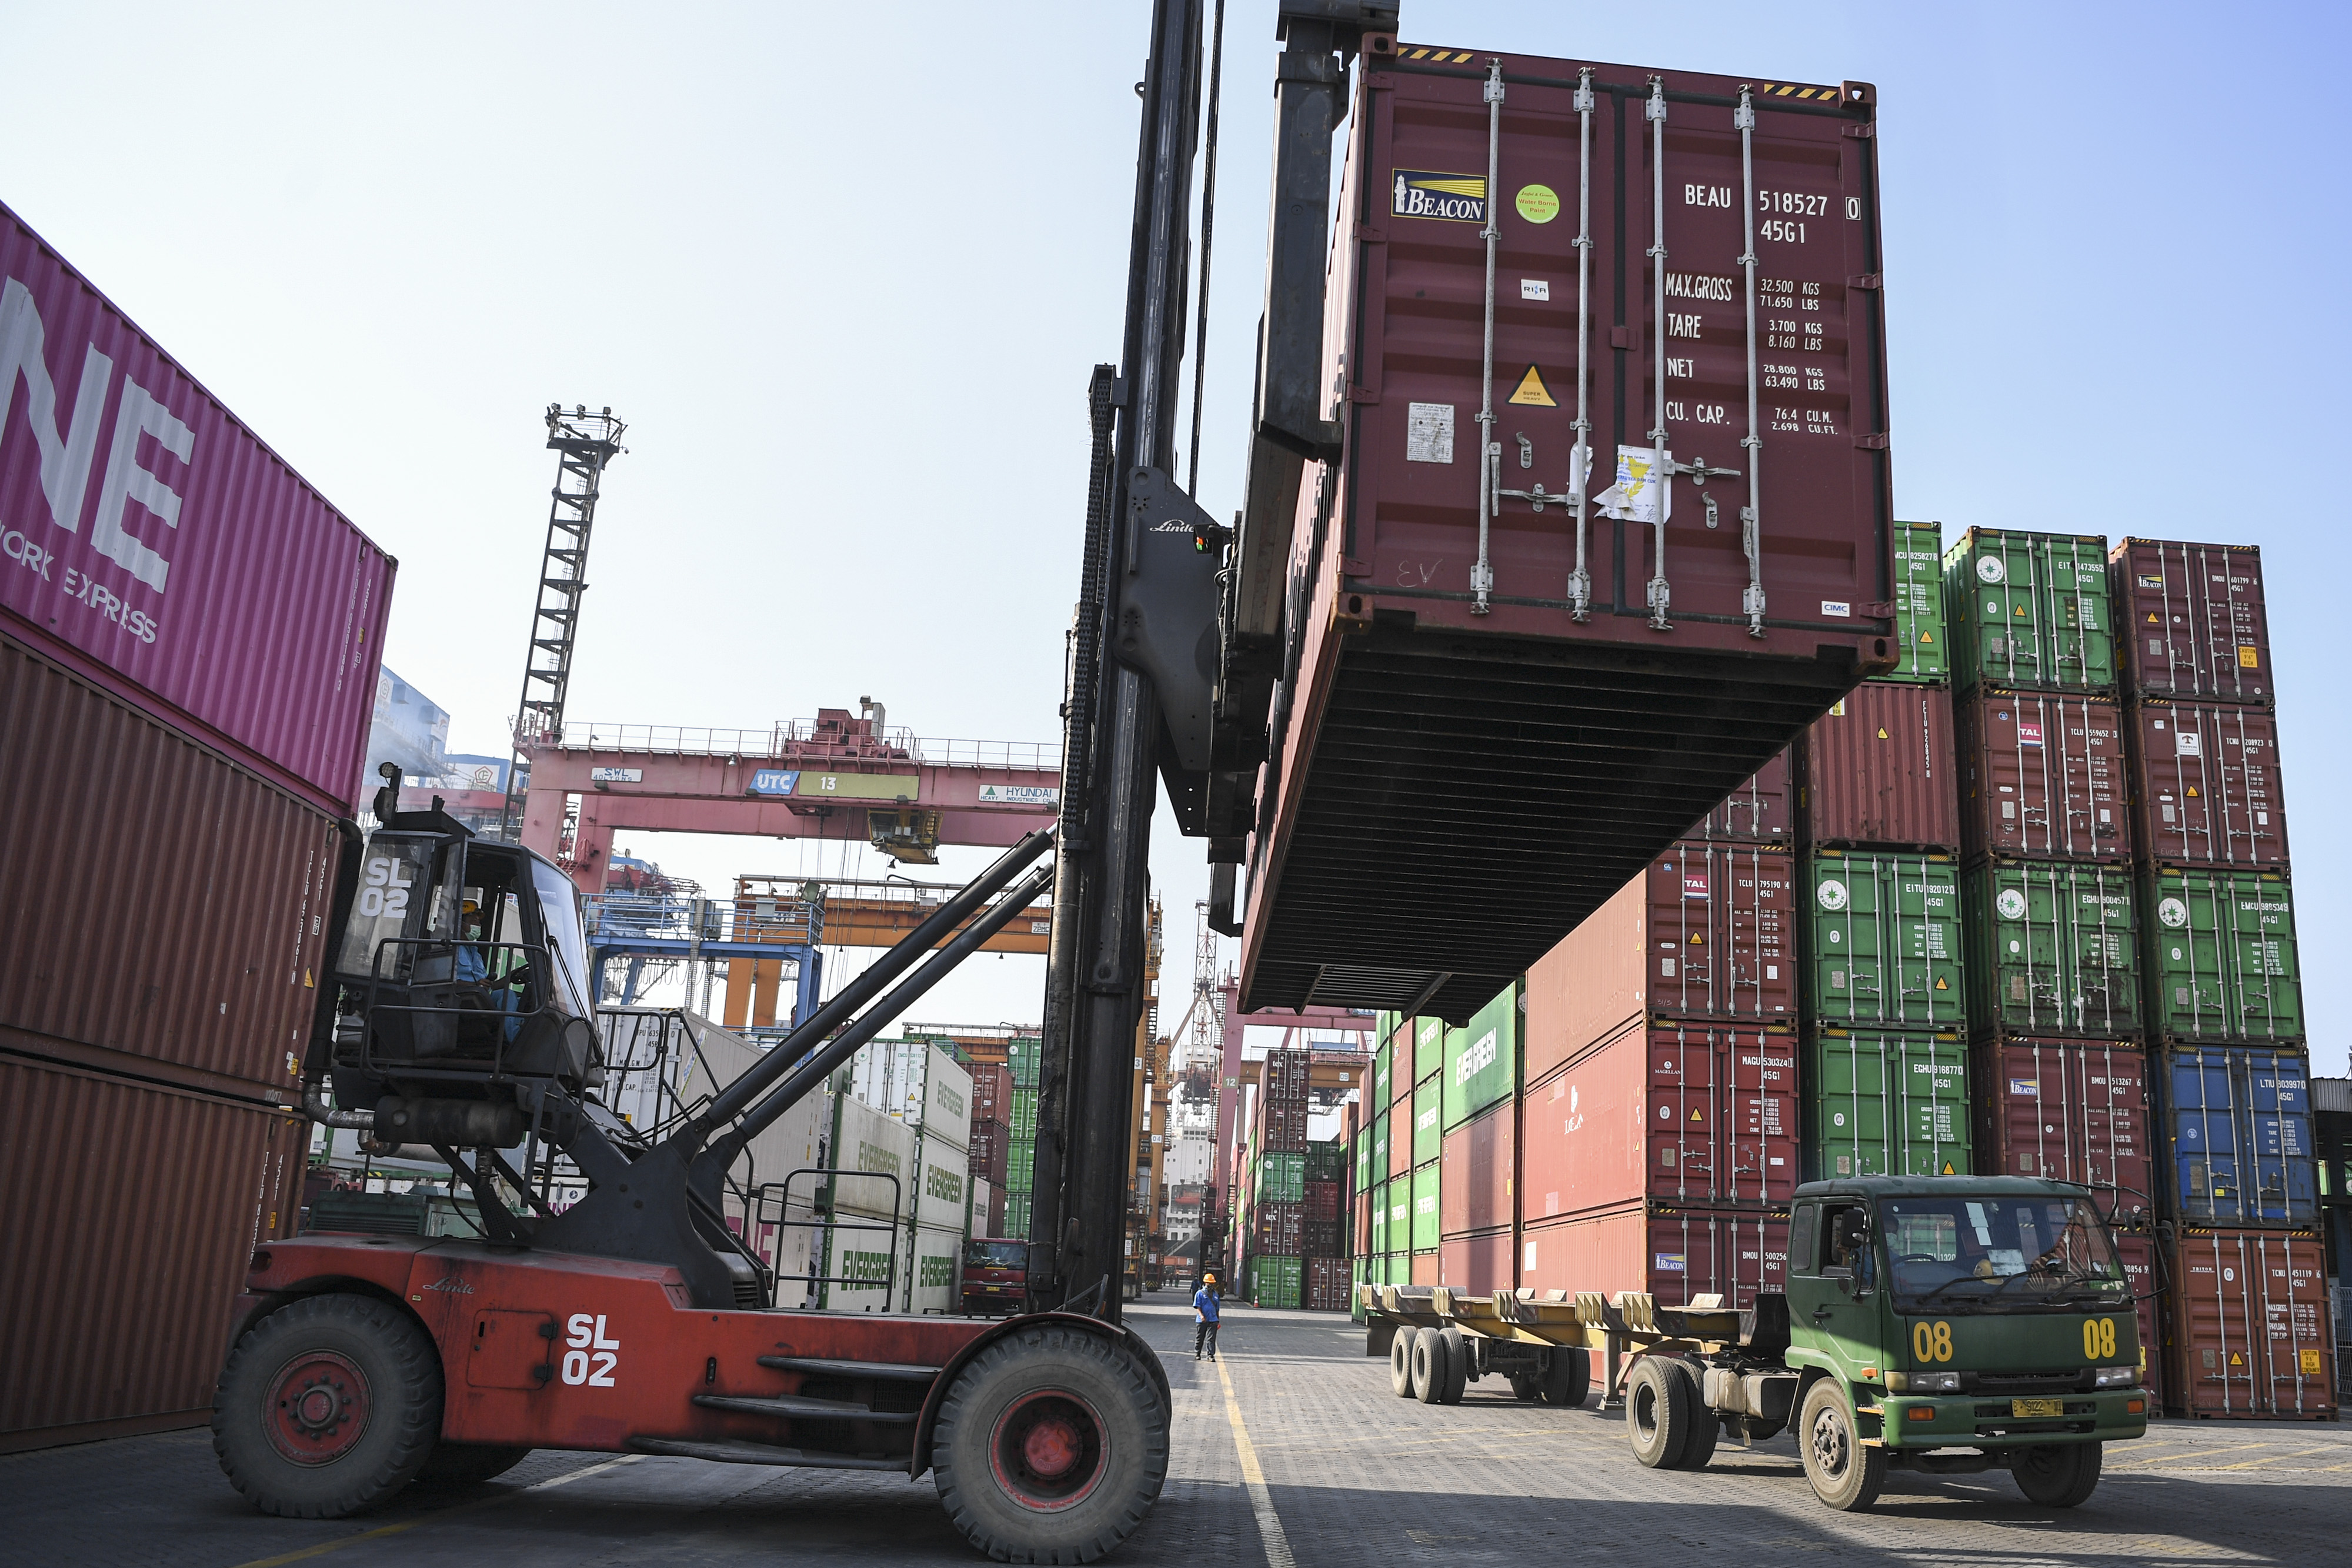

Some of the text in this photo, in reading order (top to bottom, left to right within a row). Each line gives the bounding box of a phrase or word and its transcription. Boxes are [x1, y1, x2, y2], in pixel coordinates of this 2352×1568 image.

[1406, 189, 1483, 219] BEACON
[1685, 184, 1860, 220] BEAU 518527 0
[1760, 220, 1805, 243] 45G1
[1666, 273, 1820, 301] MAX.GROSS 32,500 KGS
[1760, 295, 1819, 311] 71,650 LBS
[1667, 313, 1823, 339] TARE 3,700 KGS
[1768, 335, 1822, 351] 8,160 LBS
[1667, 358, 1693, 378] NET
[1805, 367, 1823, 377] KGS
[1764, 376, 1825, 391] 63,490 LBS
[1149, 519, 1194, 532] Linde
[1979, 569, 2002, 582] EVERGREEN
[2142, 578, 2162, 588] BEACON
[64, 567, 157, 643] EXPRESS
[1824, 604, 1848, 612] CIMC
[2089, 729, 2109, 738] 559652
[605, 768, 629, 777] SWL
[757, 775, 791, 790] UTC
[820, 776, 836, 790] 13
[1006, 787, 1052, 798] HYUNDAI
[365, 857, 412, 888] SL
[1739, 879, 1753, 888] TCLU
[1760, 880, 1780, 889] 795190
[1906, 884, 1923, 893] EITU
[359, 886, 409, 919] 02
[1820, 895, 1845, 908] EVERGREEN
[1927, 898, 1943, 906] 45G1
[2083, 895, 2099, 904] EGHU
[2241, 902, 2258, 910] EMCU
[1999, 904, 2023, 917] EVERGREEN
[2161, 913, 2185, 925] EVERGREEN
[1456, 1027, 1496, 1087] EVERGREEN
[1742, 1056, 1760, 1065] MAGU
[1914, 1064, 1931, 1073] EGHU
[1763, 1071, 1780, 1080] 45G1
[1934, 1079, 1951, 1088] 45G1
[2014, 1085, 2037, 1094] BEACON
[927, 1164, 962, 1204] EVERGREEN
[1743, 1251, 1787, 1260] BMOU 500256
[1660, 1260, 1684, 1270] BEACON
[1766, 1262, 1780, 1270] 45G1
[2272, 1269, 2286, 1277] TCNU
[422, 1276, 475, 1295] Linde
[566, 1313, 619, 1350] SL
[1913, 1320, 1953, 1363] 08
[2083, 1317, 2116, 1360] 08
[562, 1350, 618, 1387] 02
[2027, 1400, 2043, 1412] 9122
